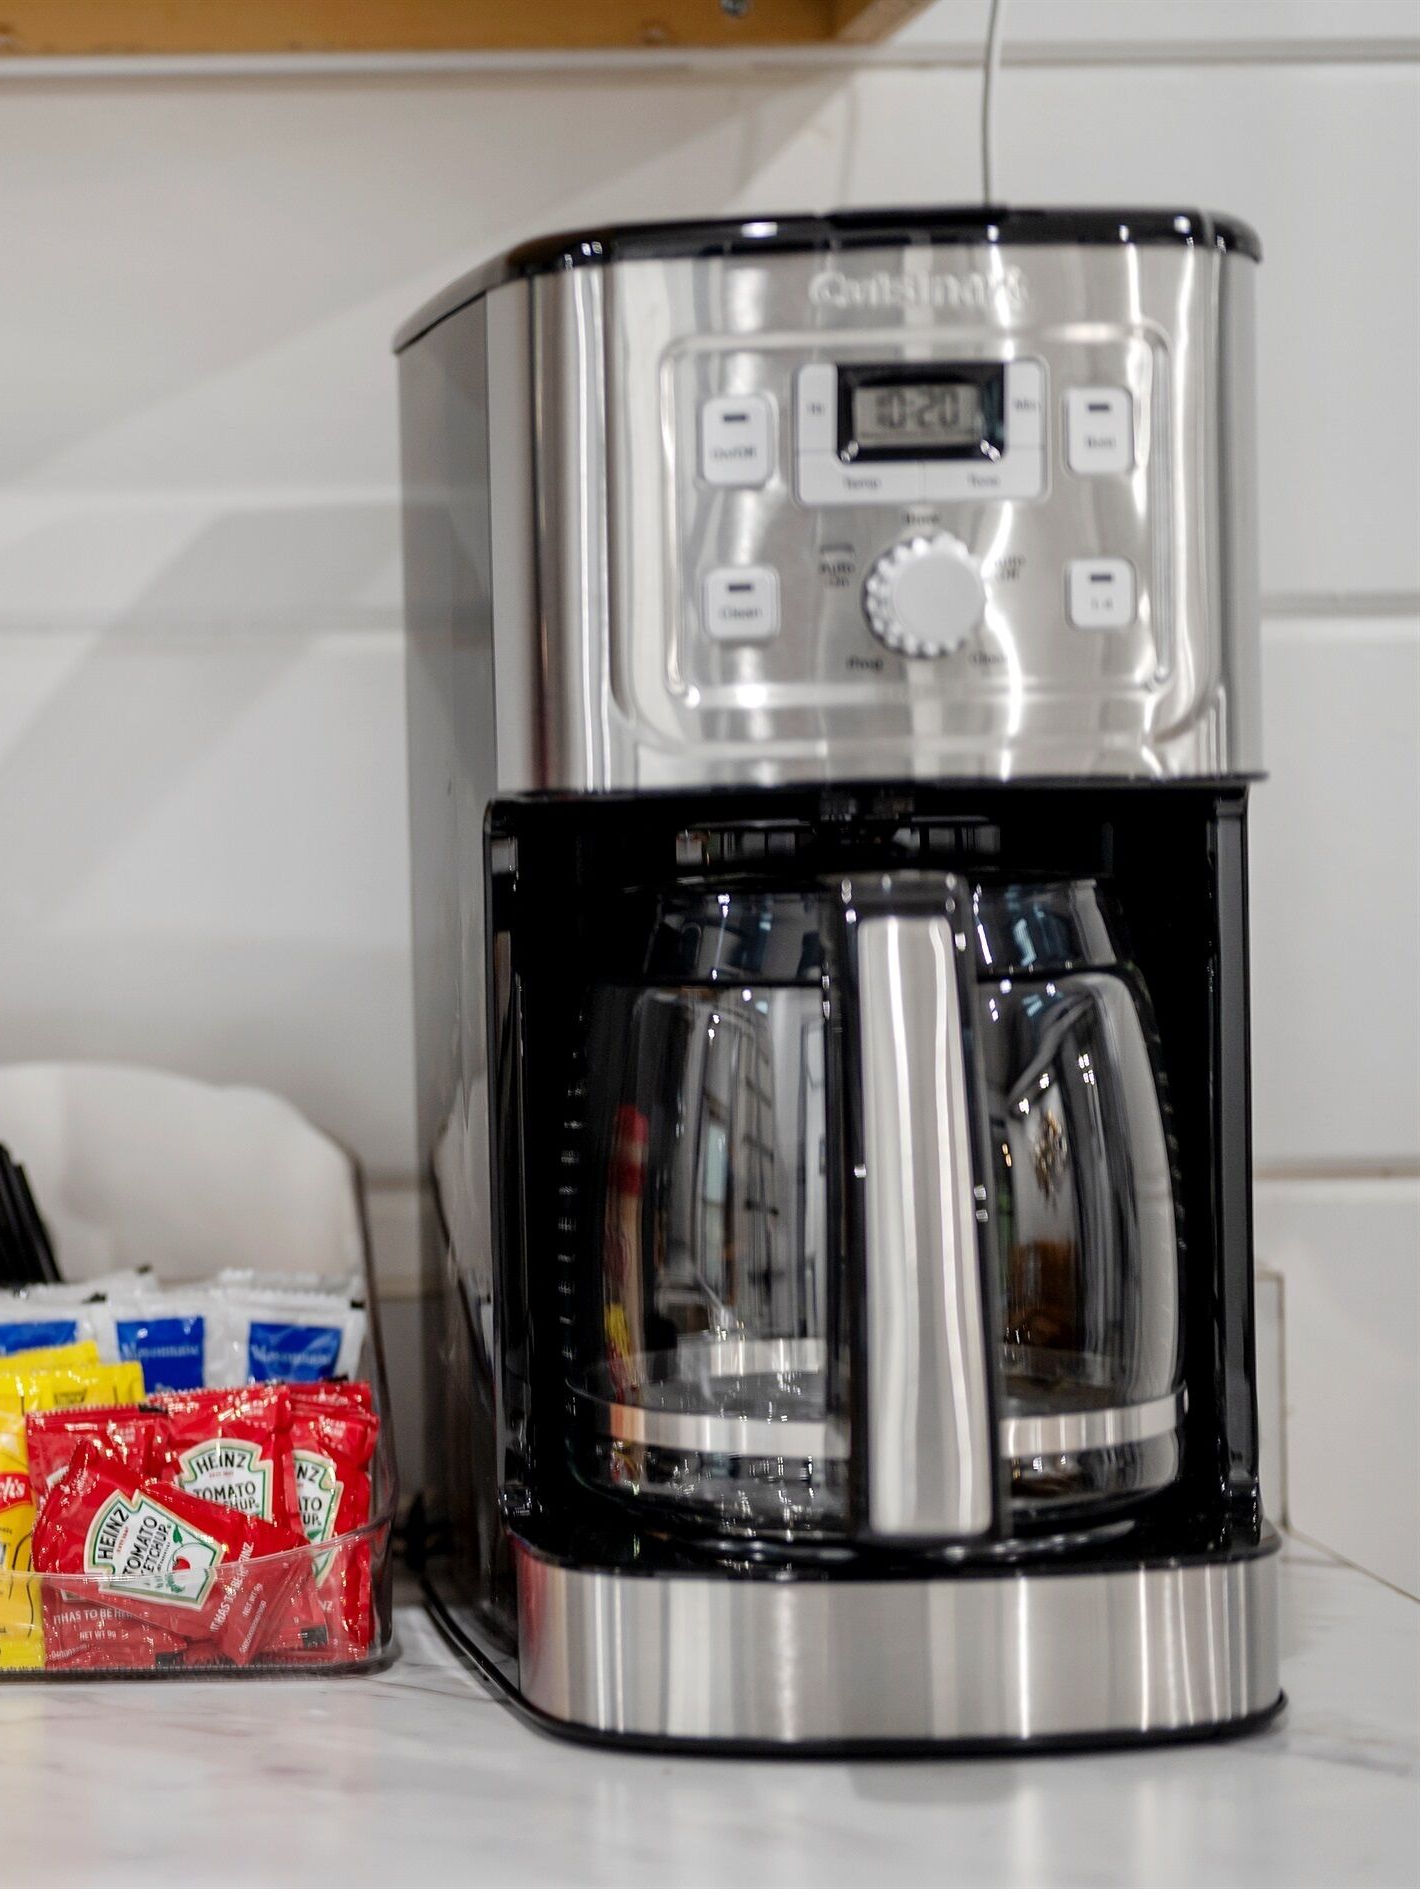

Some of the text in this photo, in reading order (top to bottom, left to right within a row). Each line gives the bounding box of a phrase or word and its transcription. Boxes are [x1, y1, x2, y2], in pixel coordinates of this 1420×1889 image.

[196, 1451, 247, 1475] HEINZ
[192, 1480, 256, 1502] TOMATO
[97, 1508, 130, 1560] HEINZ
[122, 1515, 158, 1575] TOMATO
[61, 1610, 82, 1624] HAS
[84, 1609, 98, 1621] TO
[100, 1607, 113, 1619] BE
[214, 1602, 231, 1626] HAS
[79, 1630, 92, 1641] NET
[94, 1630, 106, 1640] WT
